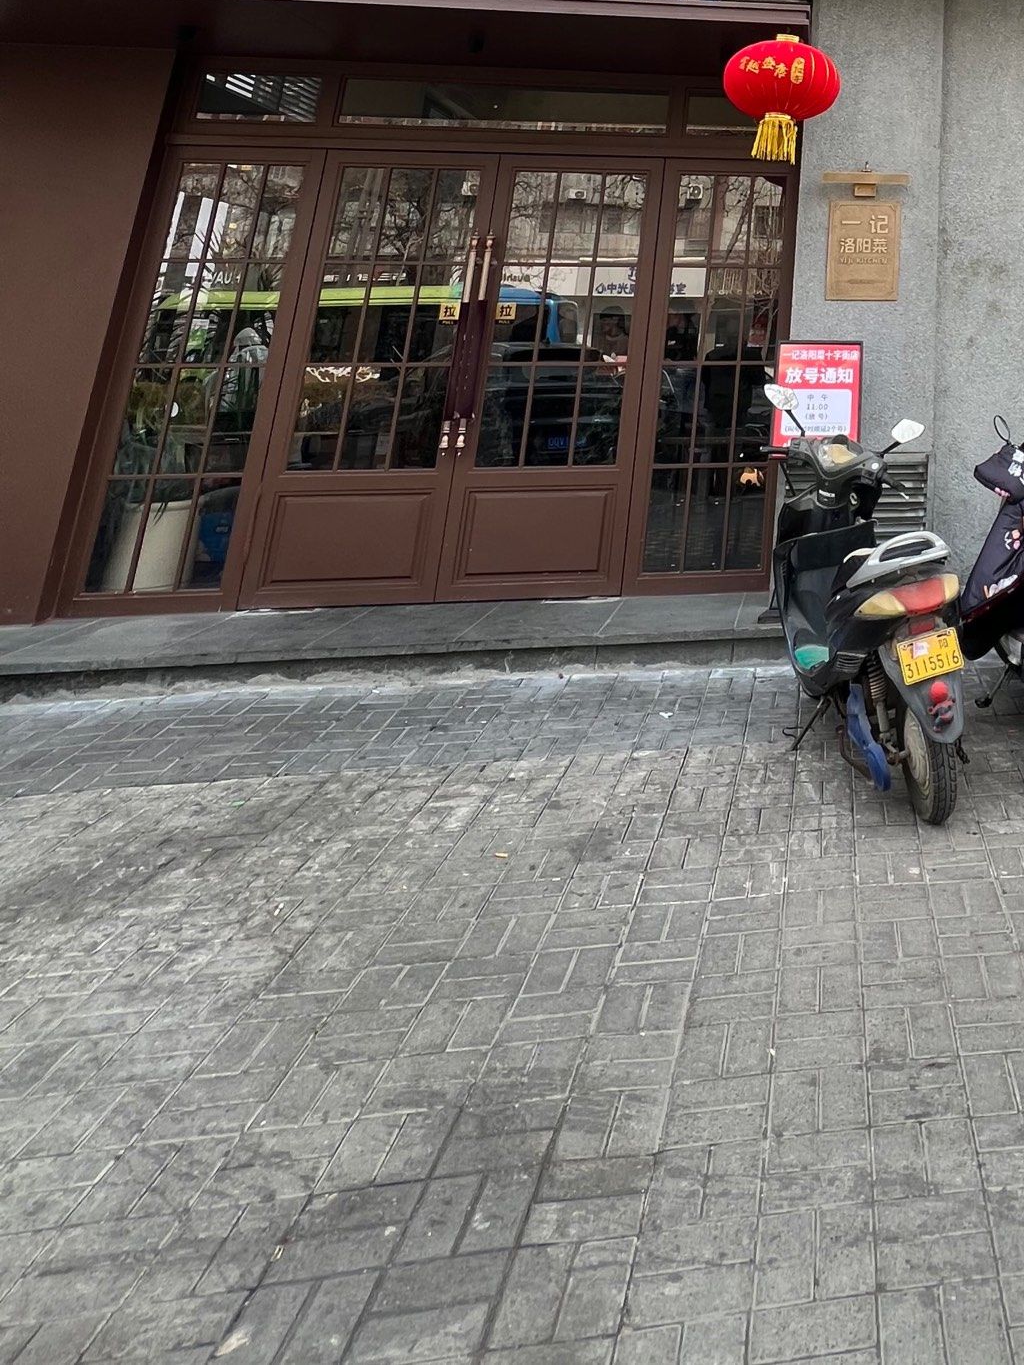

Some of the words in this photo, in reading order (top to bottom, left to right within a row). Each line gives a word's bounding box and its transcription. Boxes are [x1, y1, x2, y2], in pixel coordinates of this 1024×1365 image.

[840, 237, 888, 254] 洛阳菜
[499, 304, 513, 317] 拉
[785, 367, 854, 384] 放号通知
[905, 650, 960, 680] 3115516
